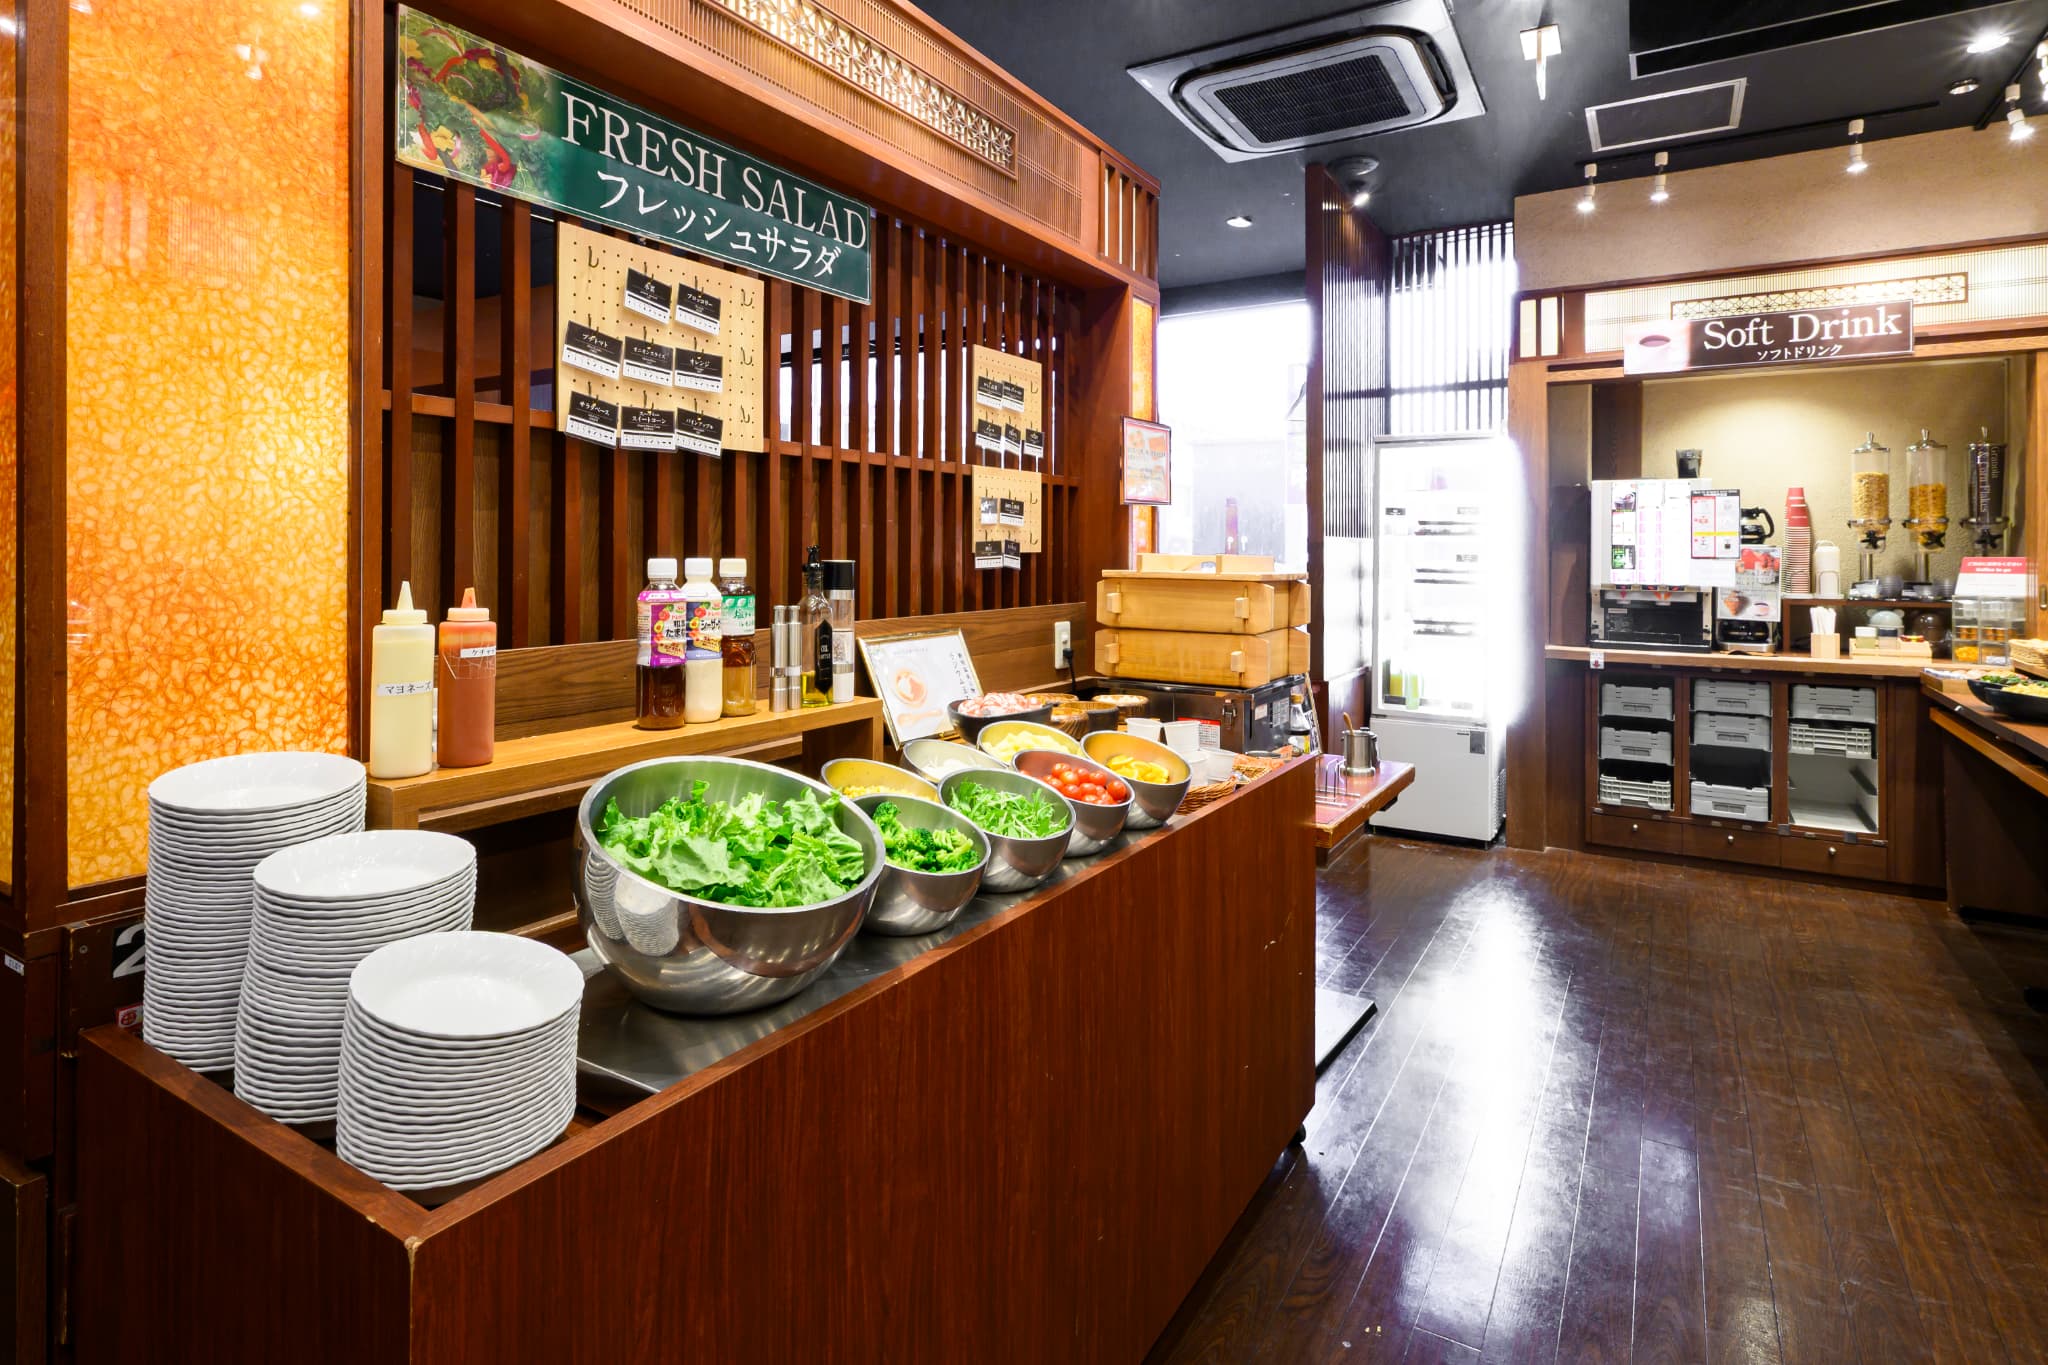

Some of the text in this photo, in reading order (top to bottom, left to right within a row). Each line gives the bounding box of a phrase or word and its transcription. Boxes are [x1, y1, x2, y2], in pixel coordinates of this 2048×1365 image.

[560, 90, 867, 249] FRESH SALAD
[597, 170, 842, 278] フレッシュサラダ
[1702, 306, 1903, 352] Soft Drink
[1756, 343, 1843, 361] ソフトドリンク
[1991, 446, 2000, 479] Granola
[385, 681, 432, 694] マヨネーズ
